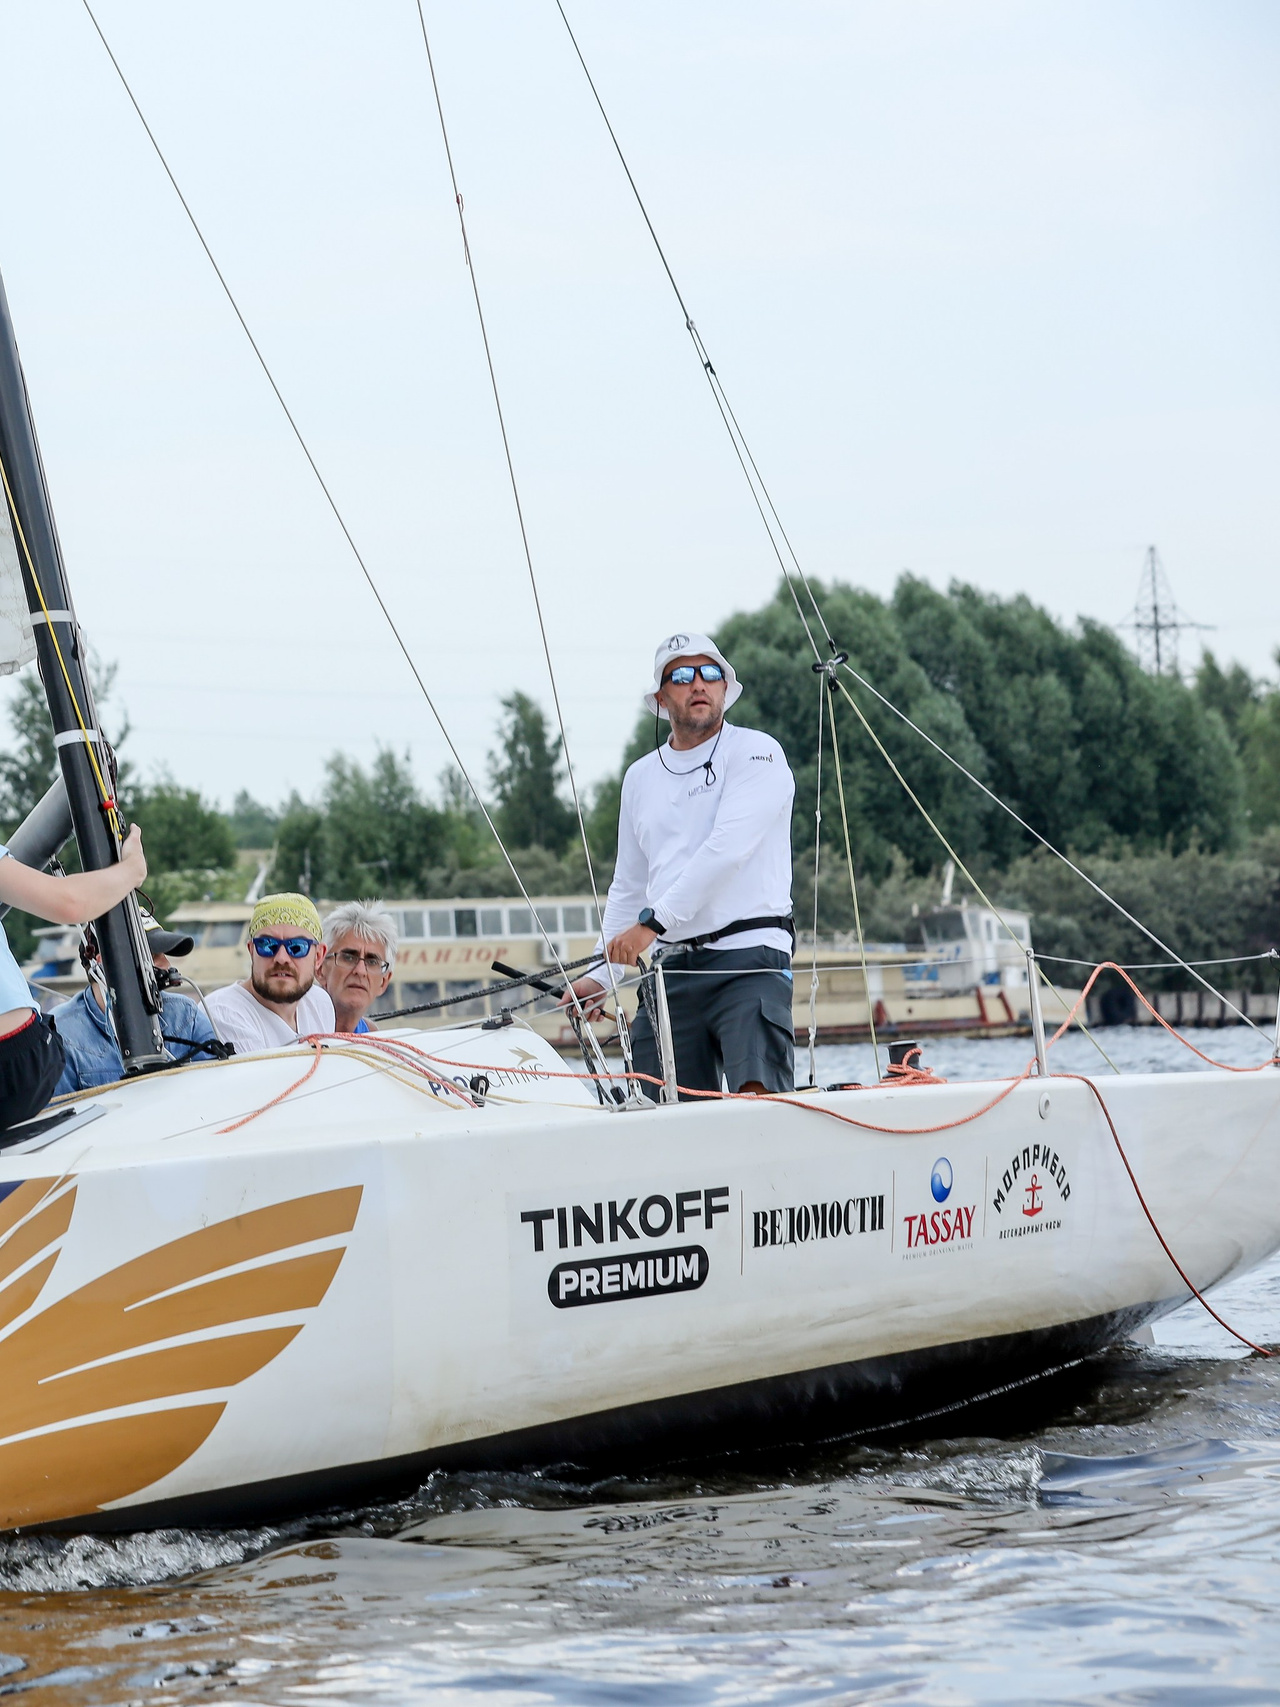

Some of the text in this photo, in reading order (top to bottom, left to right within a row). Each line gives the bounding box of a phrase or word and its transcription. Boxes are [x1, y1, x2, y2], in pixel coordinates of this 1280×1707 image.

[993, 1144, 1071, 1214] МОРПРИБОР
[520, 1186, 729, 1252] TINKOFF
[752, 1194, 885, 1250] ВЕДОМОСТИ
[903, 1205, 977, 1248] TASSAY
[558, 1253, 699, 1300] PREMIUM
